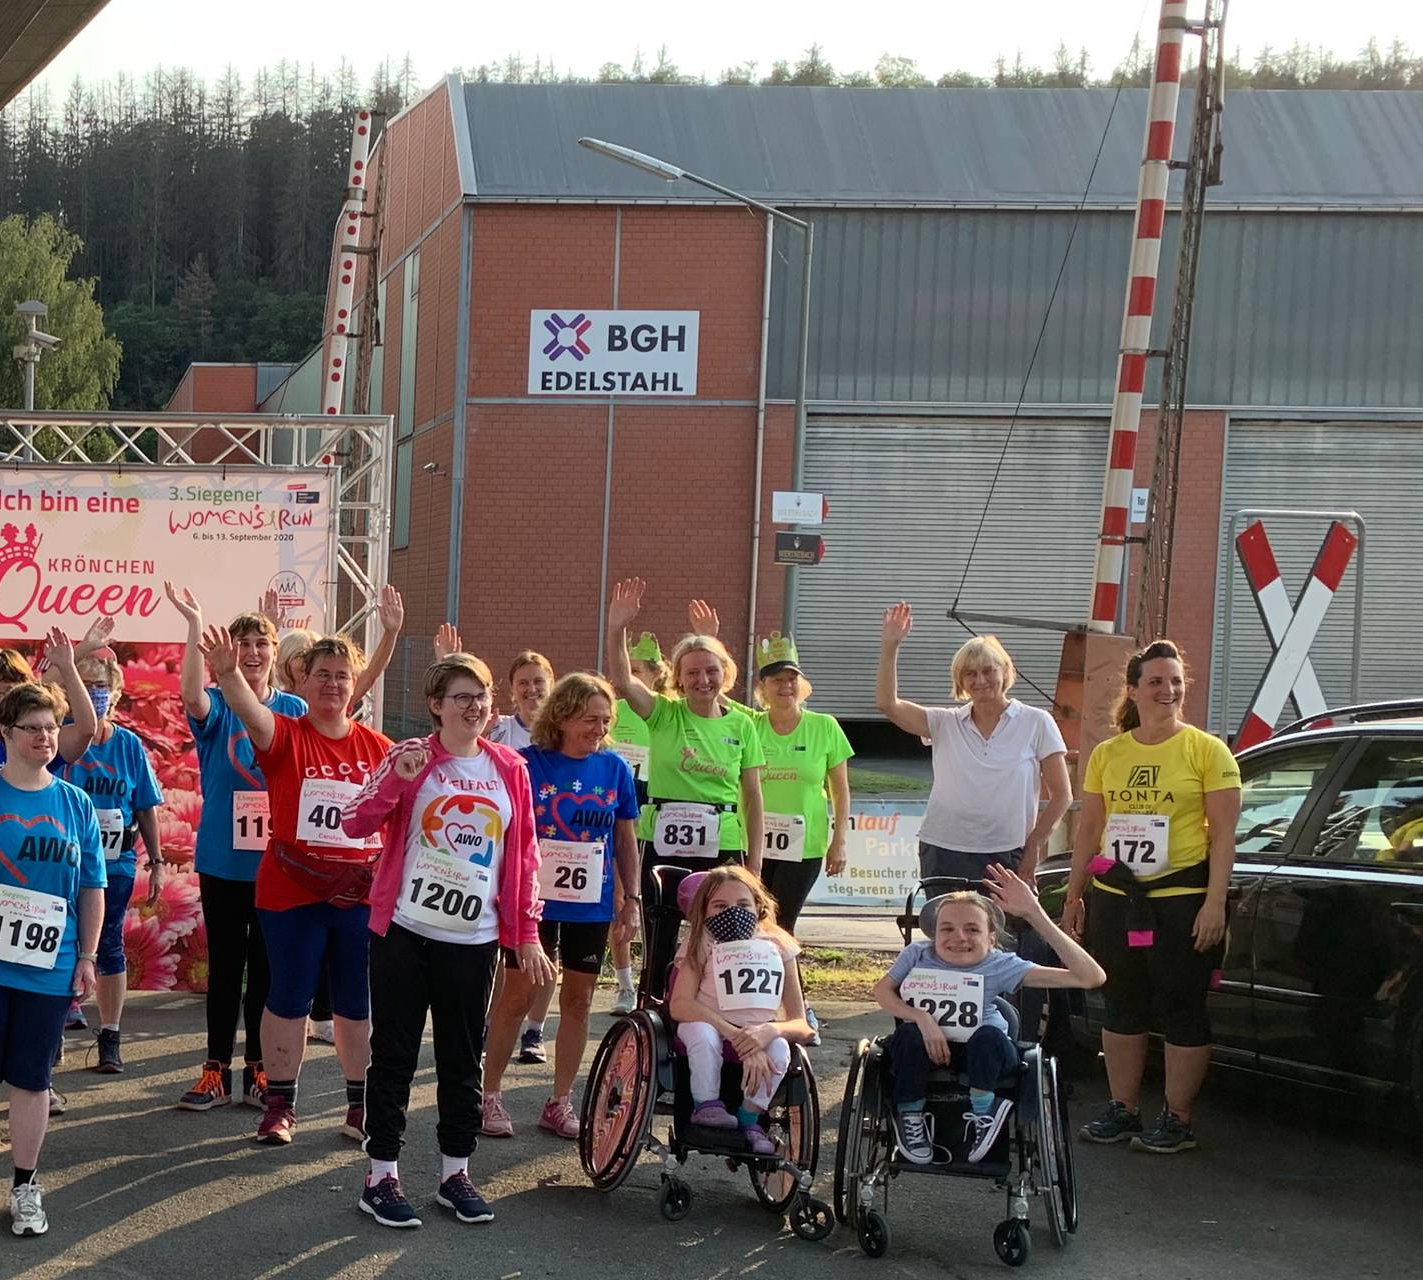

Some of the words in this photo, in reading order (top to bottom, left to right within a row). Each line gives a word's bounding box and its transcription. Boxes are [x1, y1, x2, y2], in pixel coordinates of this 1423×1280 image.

[608, 324, 686, 352] BGH
[541, 371, 684, 392] EDELSTAHL
[40, 490, 78, 512] bin
[87, 491, 140, 513] eine
[169, 486, 183, 500] 3.
[186, 486, 263, 505] Siegener
[202, 532, 214, 540] bis
[230, 533, 271, 542] September
[273, 533, 294, 541] 2020
[48, 555, 155, 574] KRÖNCHEN
[85, 776, 128, 796] AWO
[1108, 790, 1174, 802] ZONTA
[569, 809, 613, 828] AWO
[454, 833, 482, 846] AWO
[664, 824, 707, 846] 831
[17, 836, 80, 867] AWO
[1111, 839, 1156, 863] 172
[554, 866, 587, 890] 26
[850, 867, 903, 878] Besucher
[411, 877, 482, 921] 1200
[827, 884, 894, 896] sieg-arena
[719, 968, 782, 995] 1227
